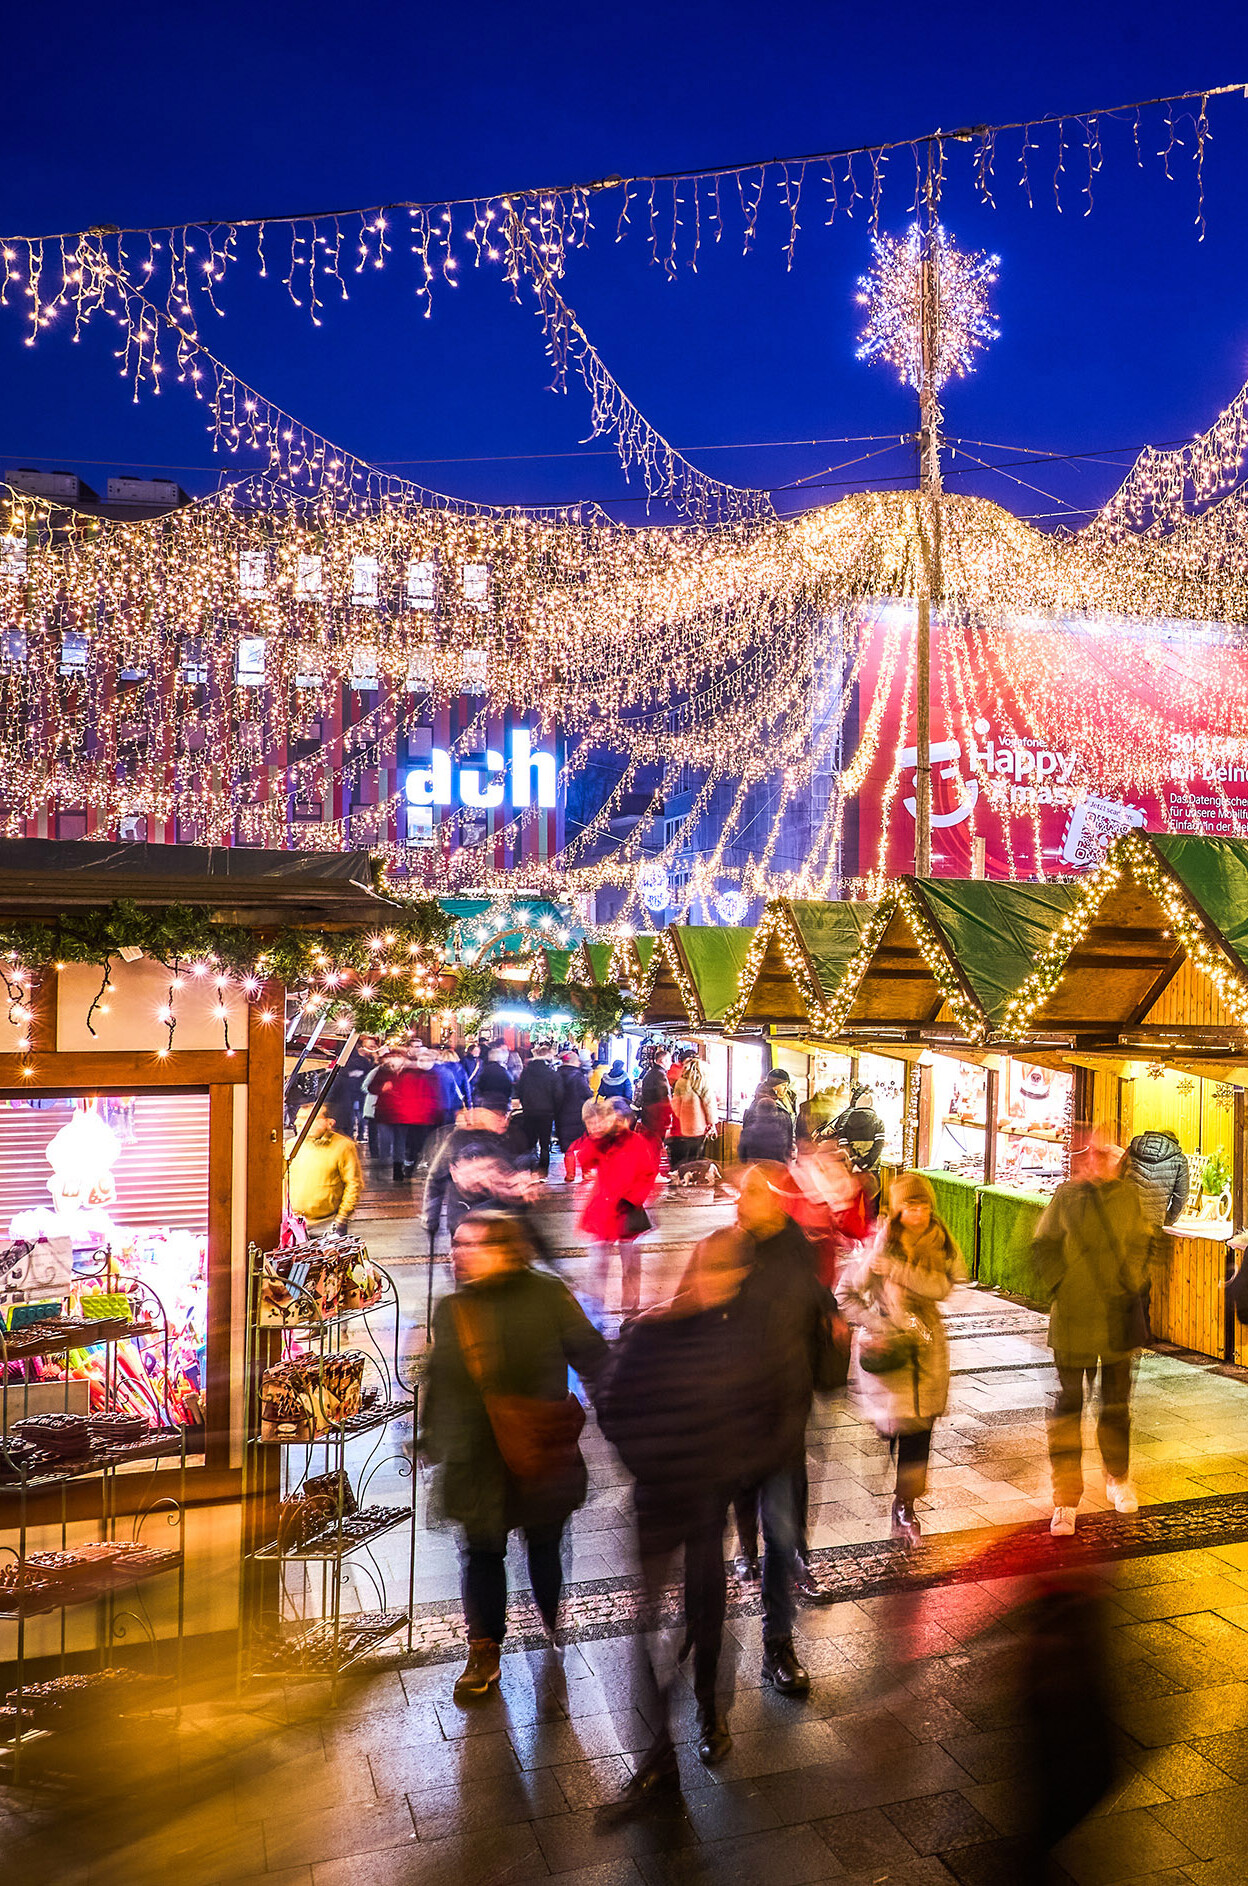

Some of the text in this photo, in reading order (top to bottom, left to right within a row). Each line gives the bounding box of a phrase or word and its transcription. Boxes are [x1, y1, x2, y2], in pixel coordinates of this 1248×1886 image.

[998, 735, 1048, 748] Vodafone
[969, 740, 1078, 784] Happy
[1169, 792, 1188, 804] Das
[1170, 805, 1183, 817] für
[1215, 821, 1231, 832] der
